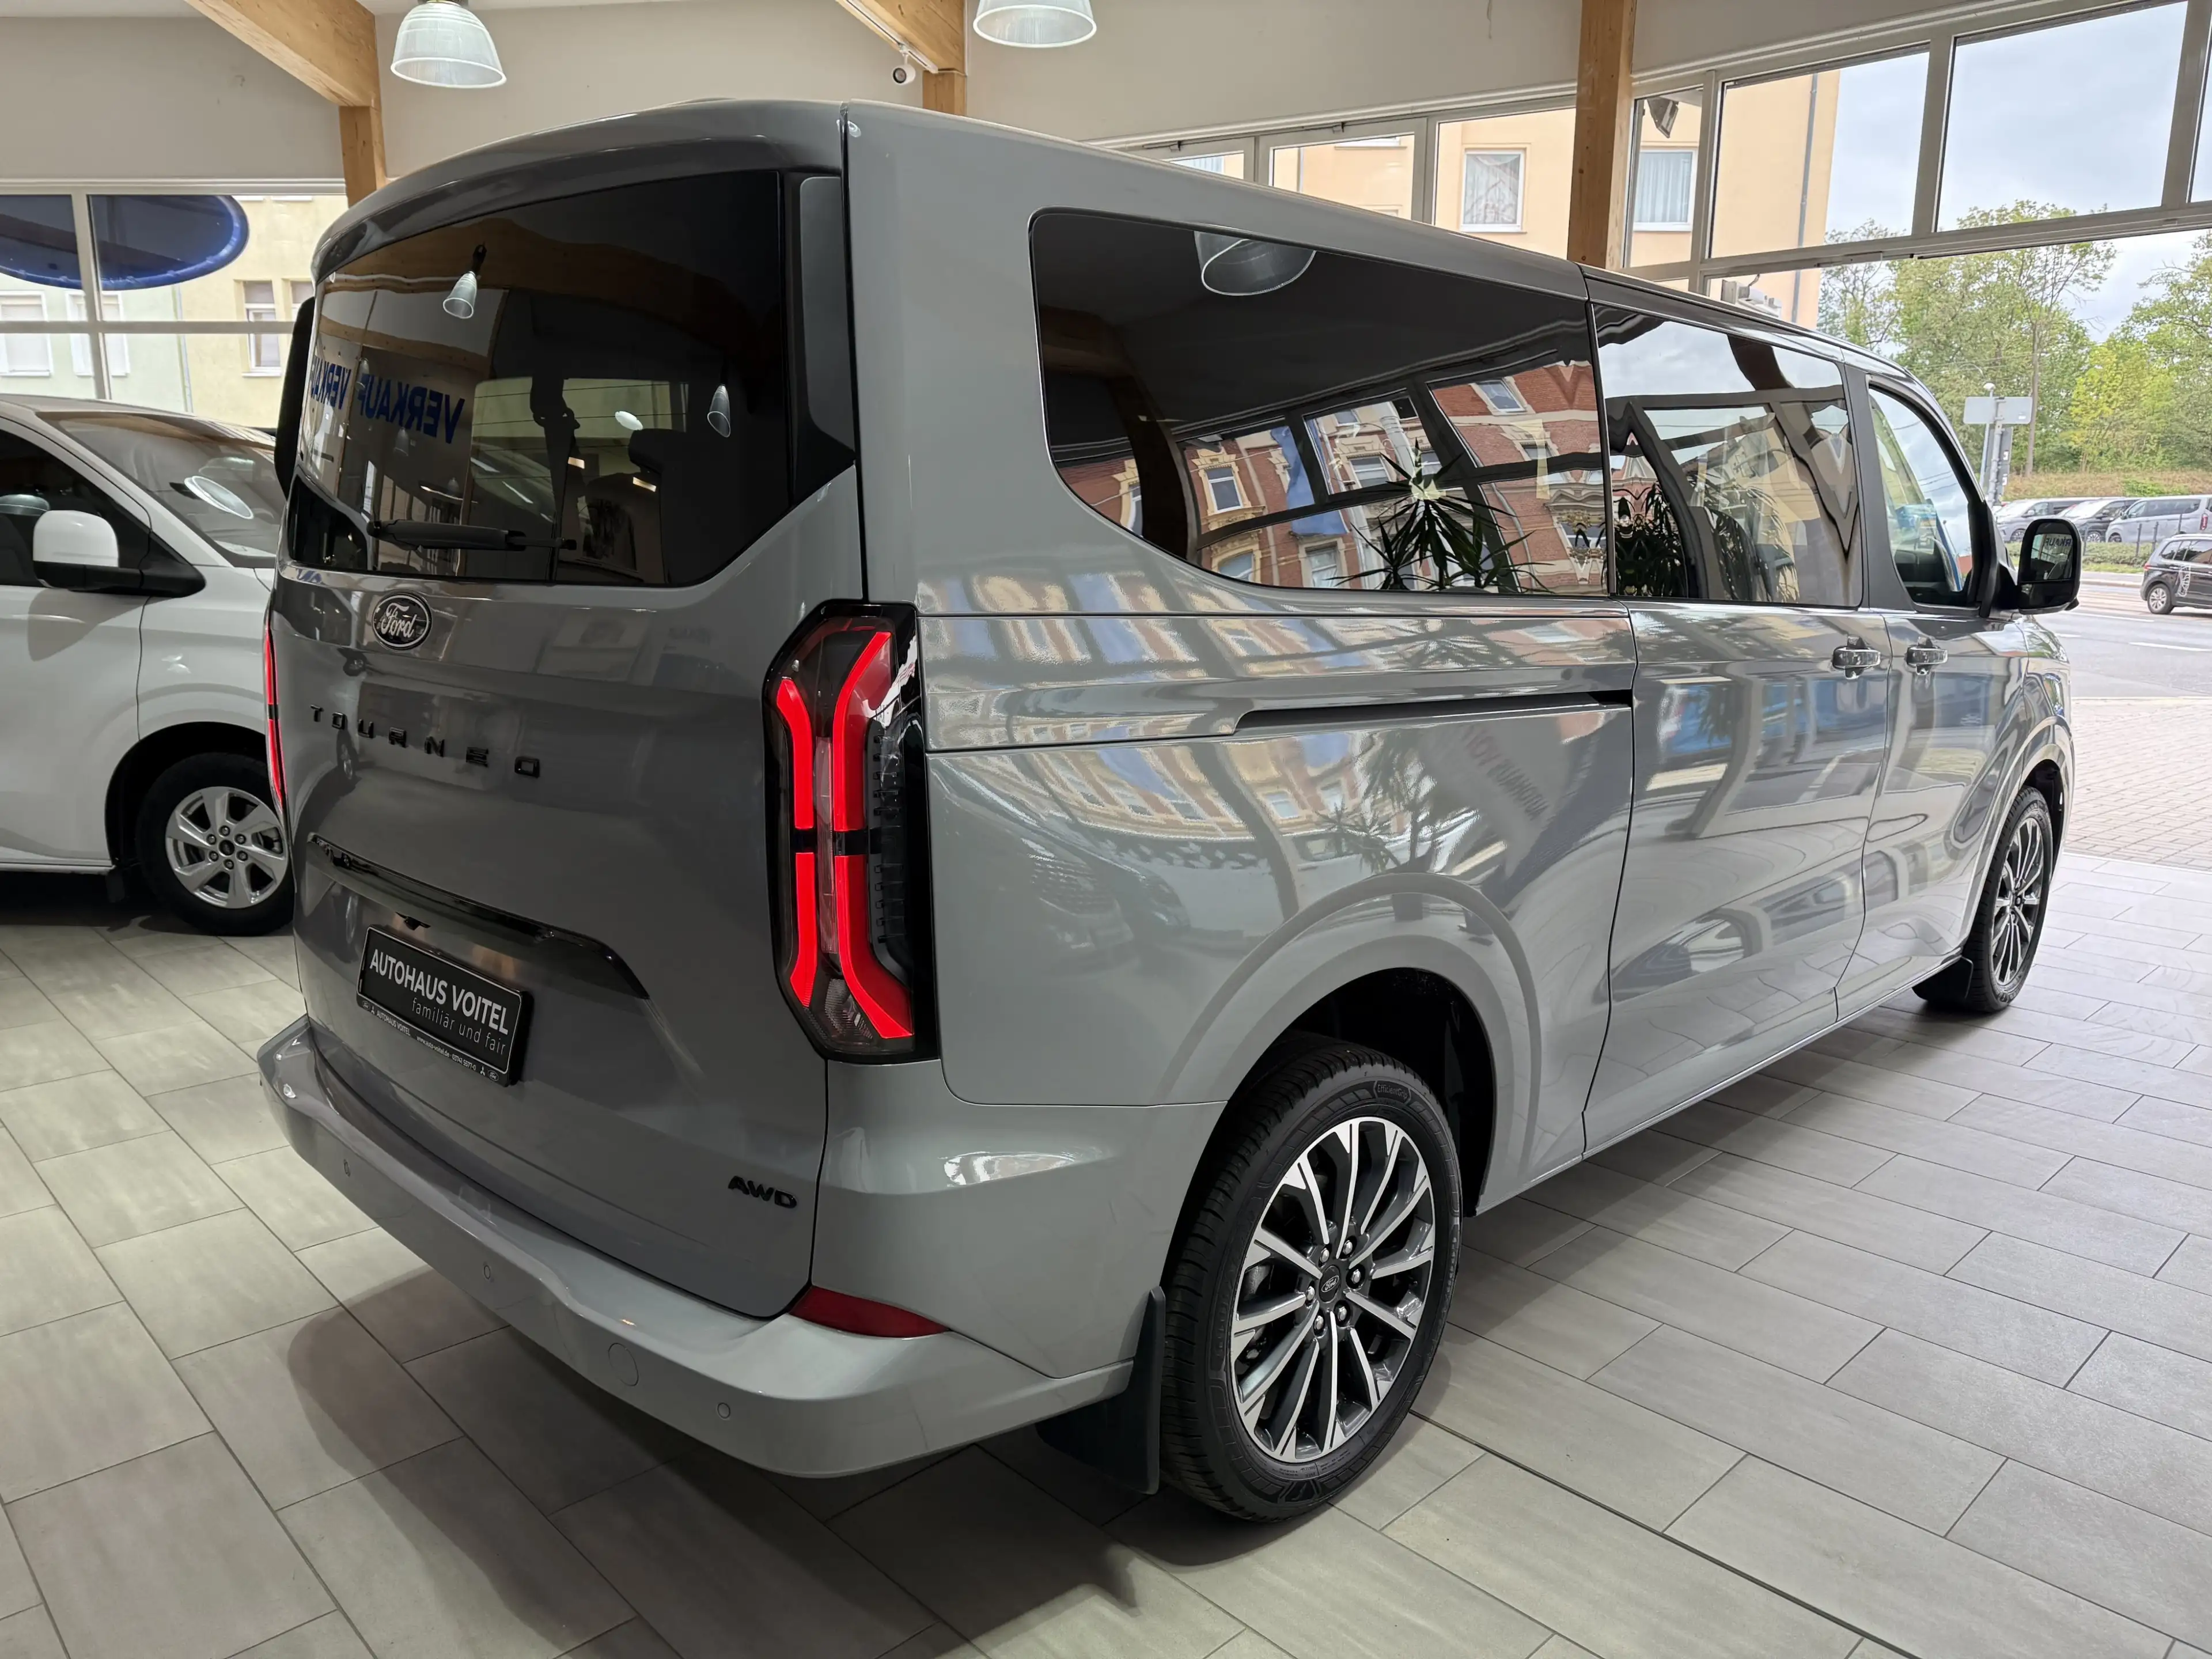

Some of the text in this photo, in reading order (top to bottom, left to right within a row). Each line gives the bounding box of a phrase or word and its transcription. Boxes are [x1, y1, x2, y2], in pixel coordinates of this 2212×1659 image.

[380, 602, 418, 638] Ford
[309, 704, 541, 778] TOURNEO
[369, 949, 509, 1035] AUTOHAUS VOITEL
[377, 1010, 396, 1028] AUTOHAUS
[396, 1022, 411, 1036] VOITEL
[412, 997, 506, 1055] familiär und fair
[1377, 1084, 1408, 1101] EfficientGrip
[728, 1175, 797, 1209] AWD
